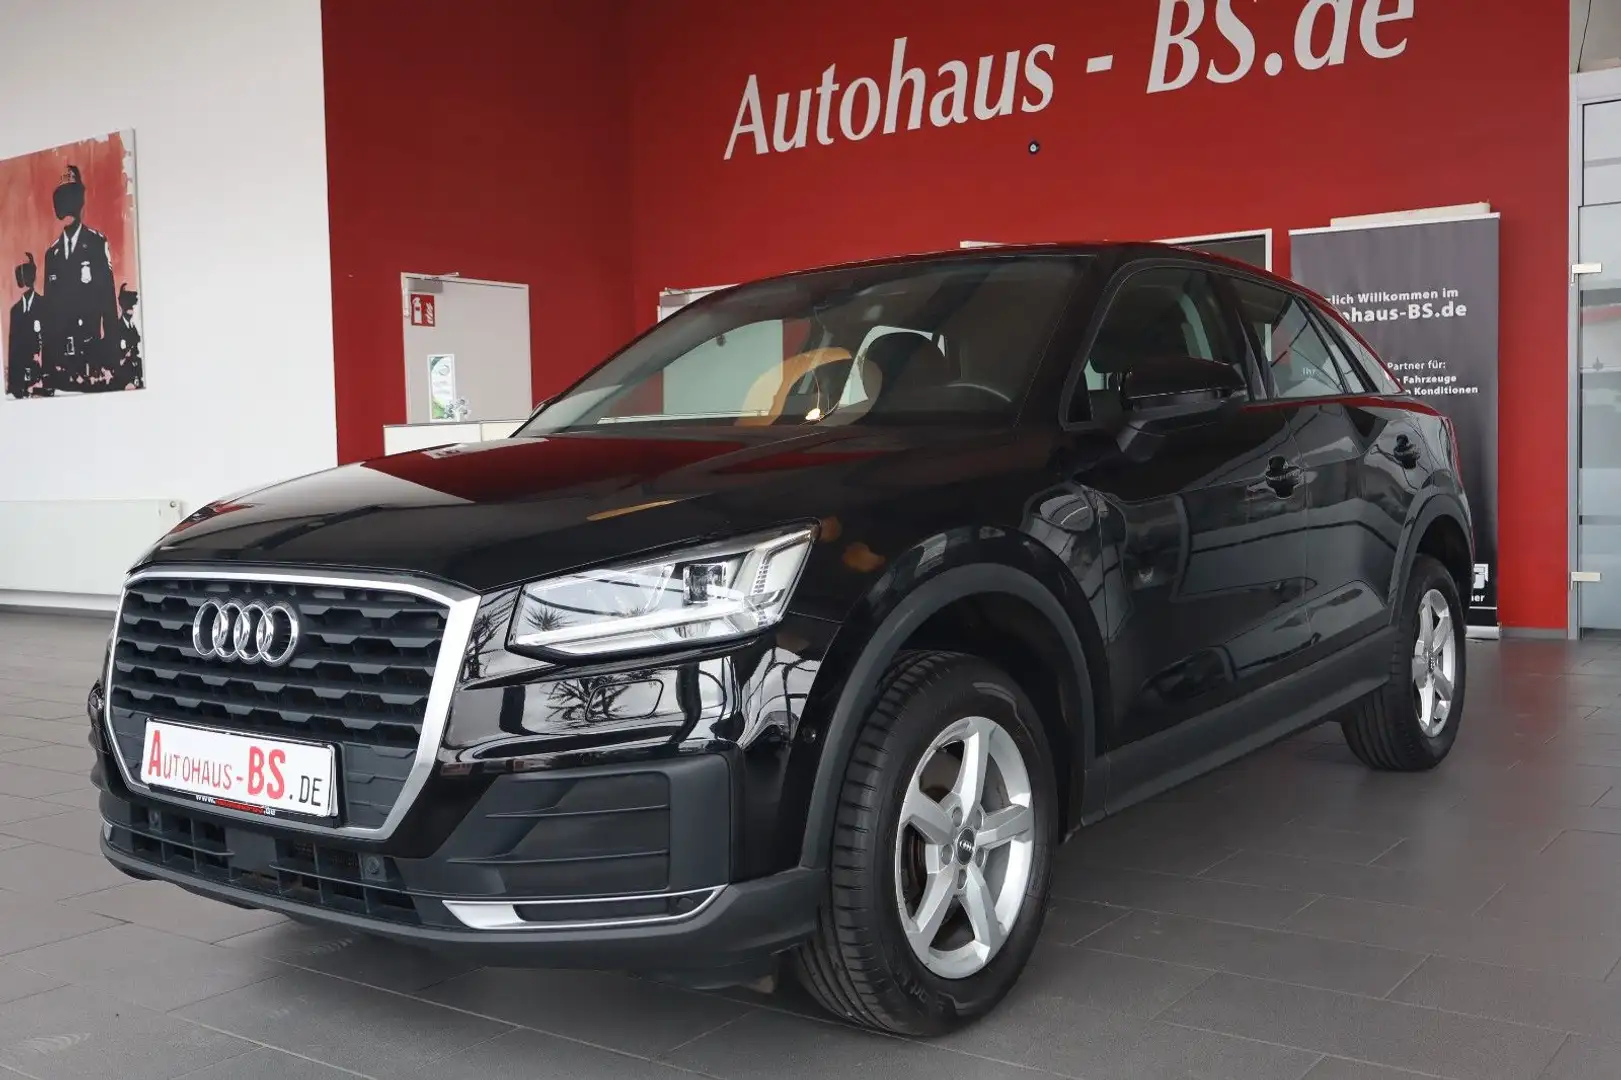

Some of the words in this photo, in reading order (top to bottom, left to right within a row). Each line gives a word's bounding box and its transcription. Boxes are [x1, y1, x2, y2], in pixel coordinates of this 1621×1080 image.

[723, 36, 1056, 160] Autohaus
[1146, 0, 1414, 94] BS.de
[1357, 290, 1438, 303] Willkommen
[1442, 287, 1459, 298] im
[1387, 361, 1425, 371] Partner
[1428, 360, 1446, 369] für:
[1403, 375, 1457, 385] Fahrzeuge
[1414, 386, 1479, 396] Konditionen
